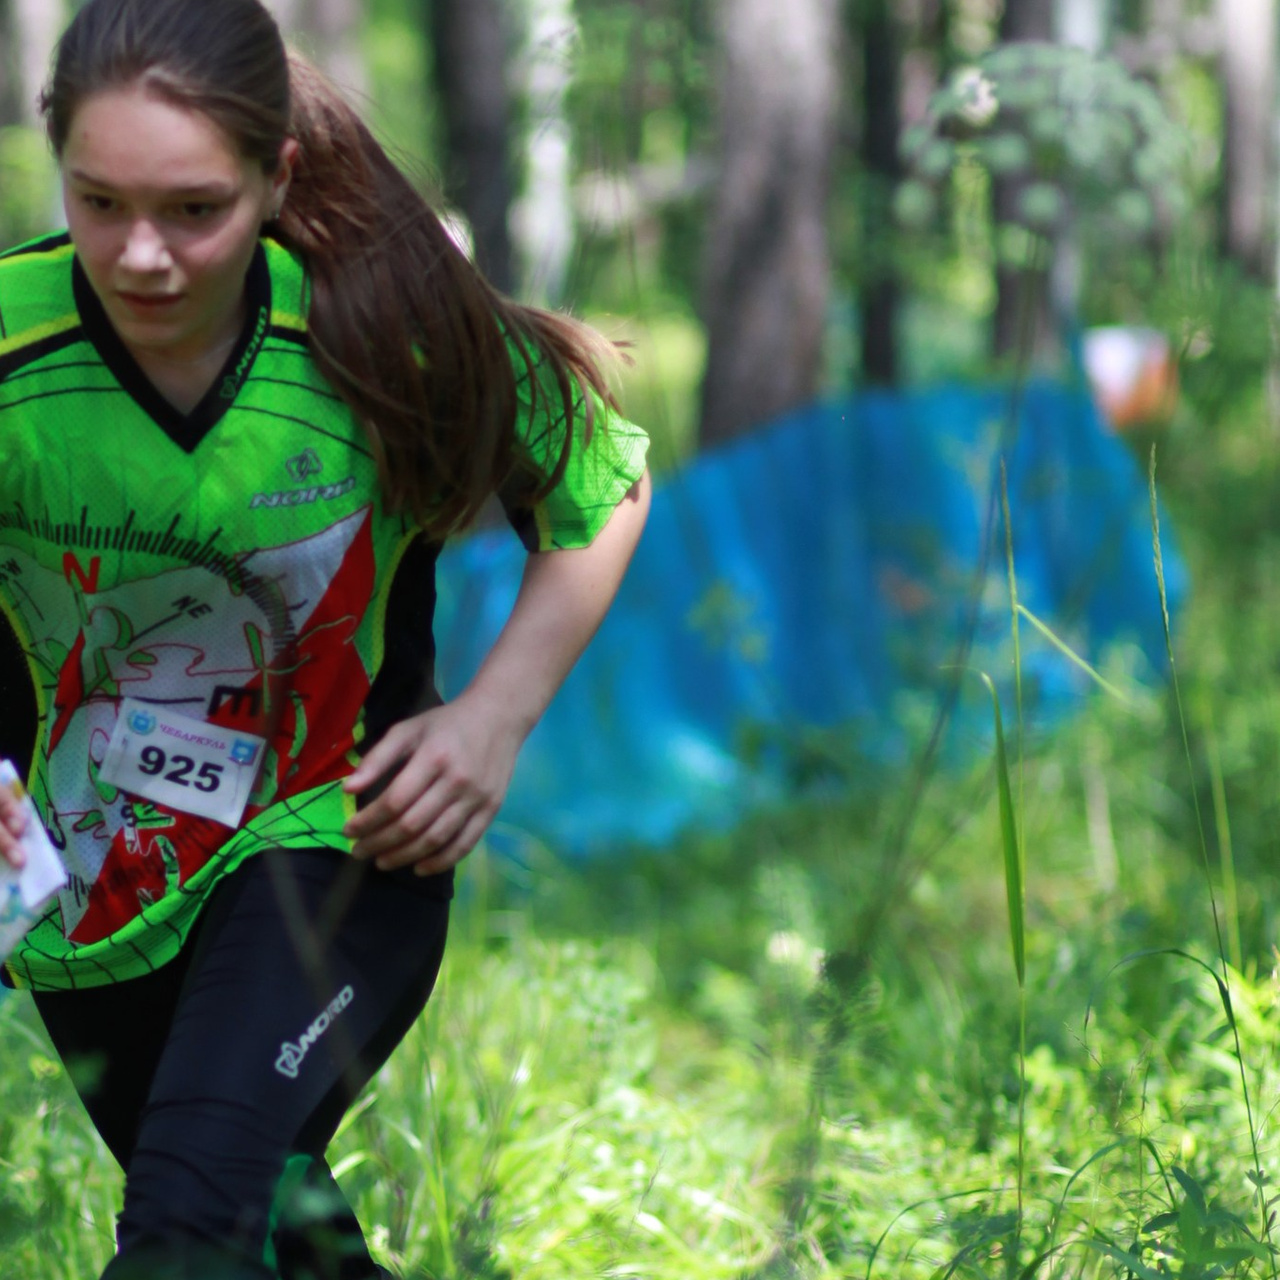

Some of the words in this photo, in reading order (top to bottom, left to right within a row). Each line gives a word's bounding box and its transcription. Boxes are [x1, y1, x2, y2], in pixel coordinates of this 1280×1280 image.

[63, 551, 100, 593] N
[171, 596, 214, 619] NE
[159, 723, 226, 750] ЧЕБАРКУЛЬ
[138, 745, 224, 793] 925
[299, 985, 353, 1052] NORD
